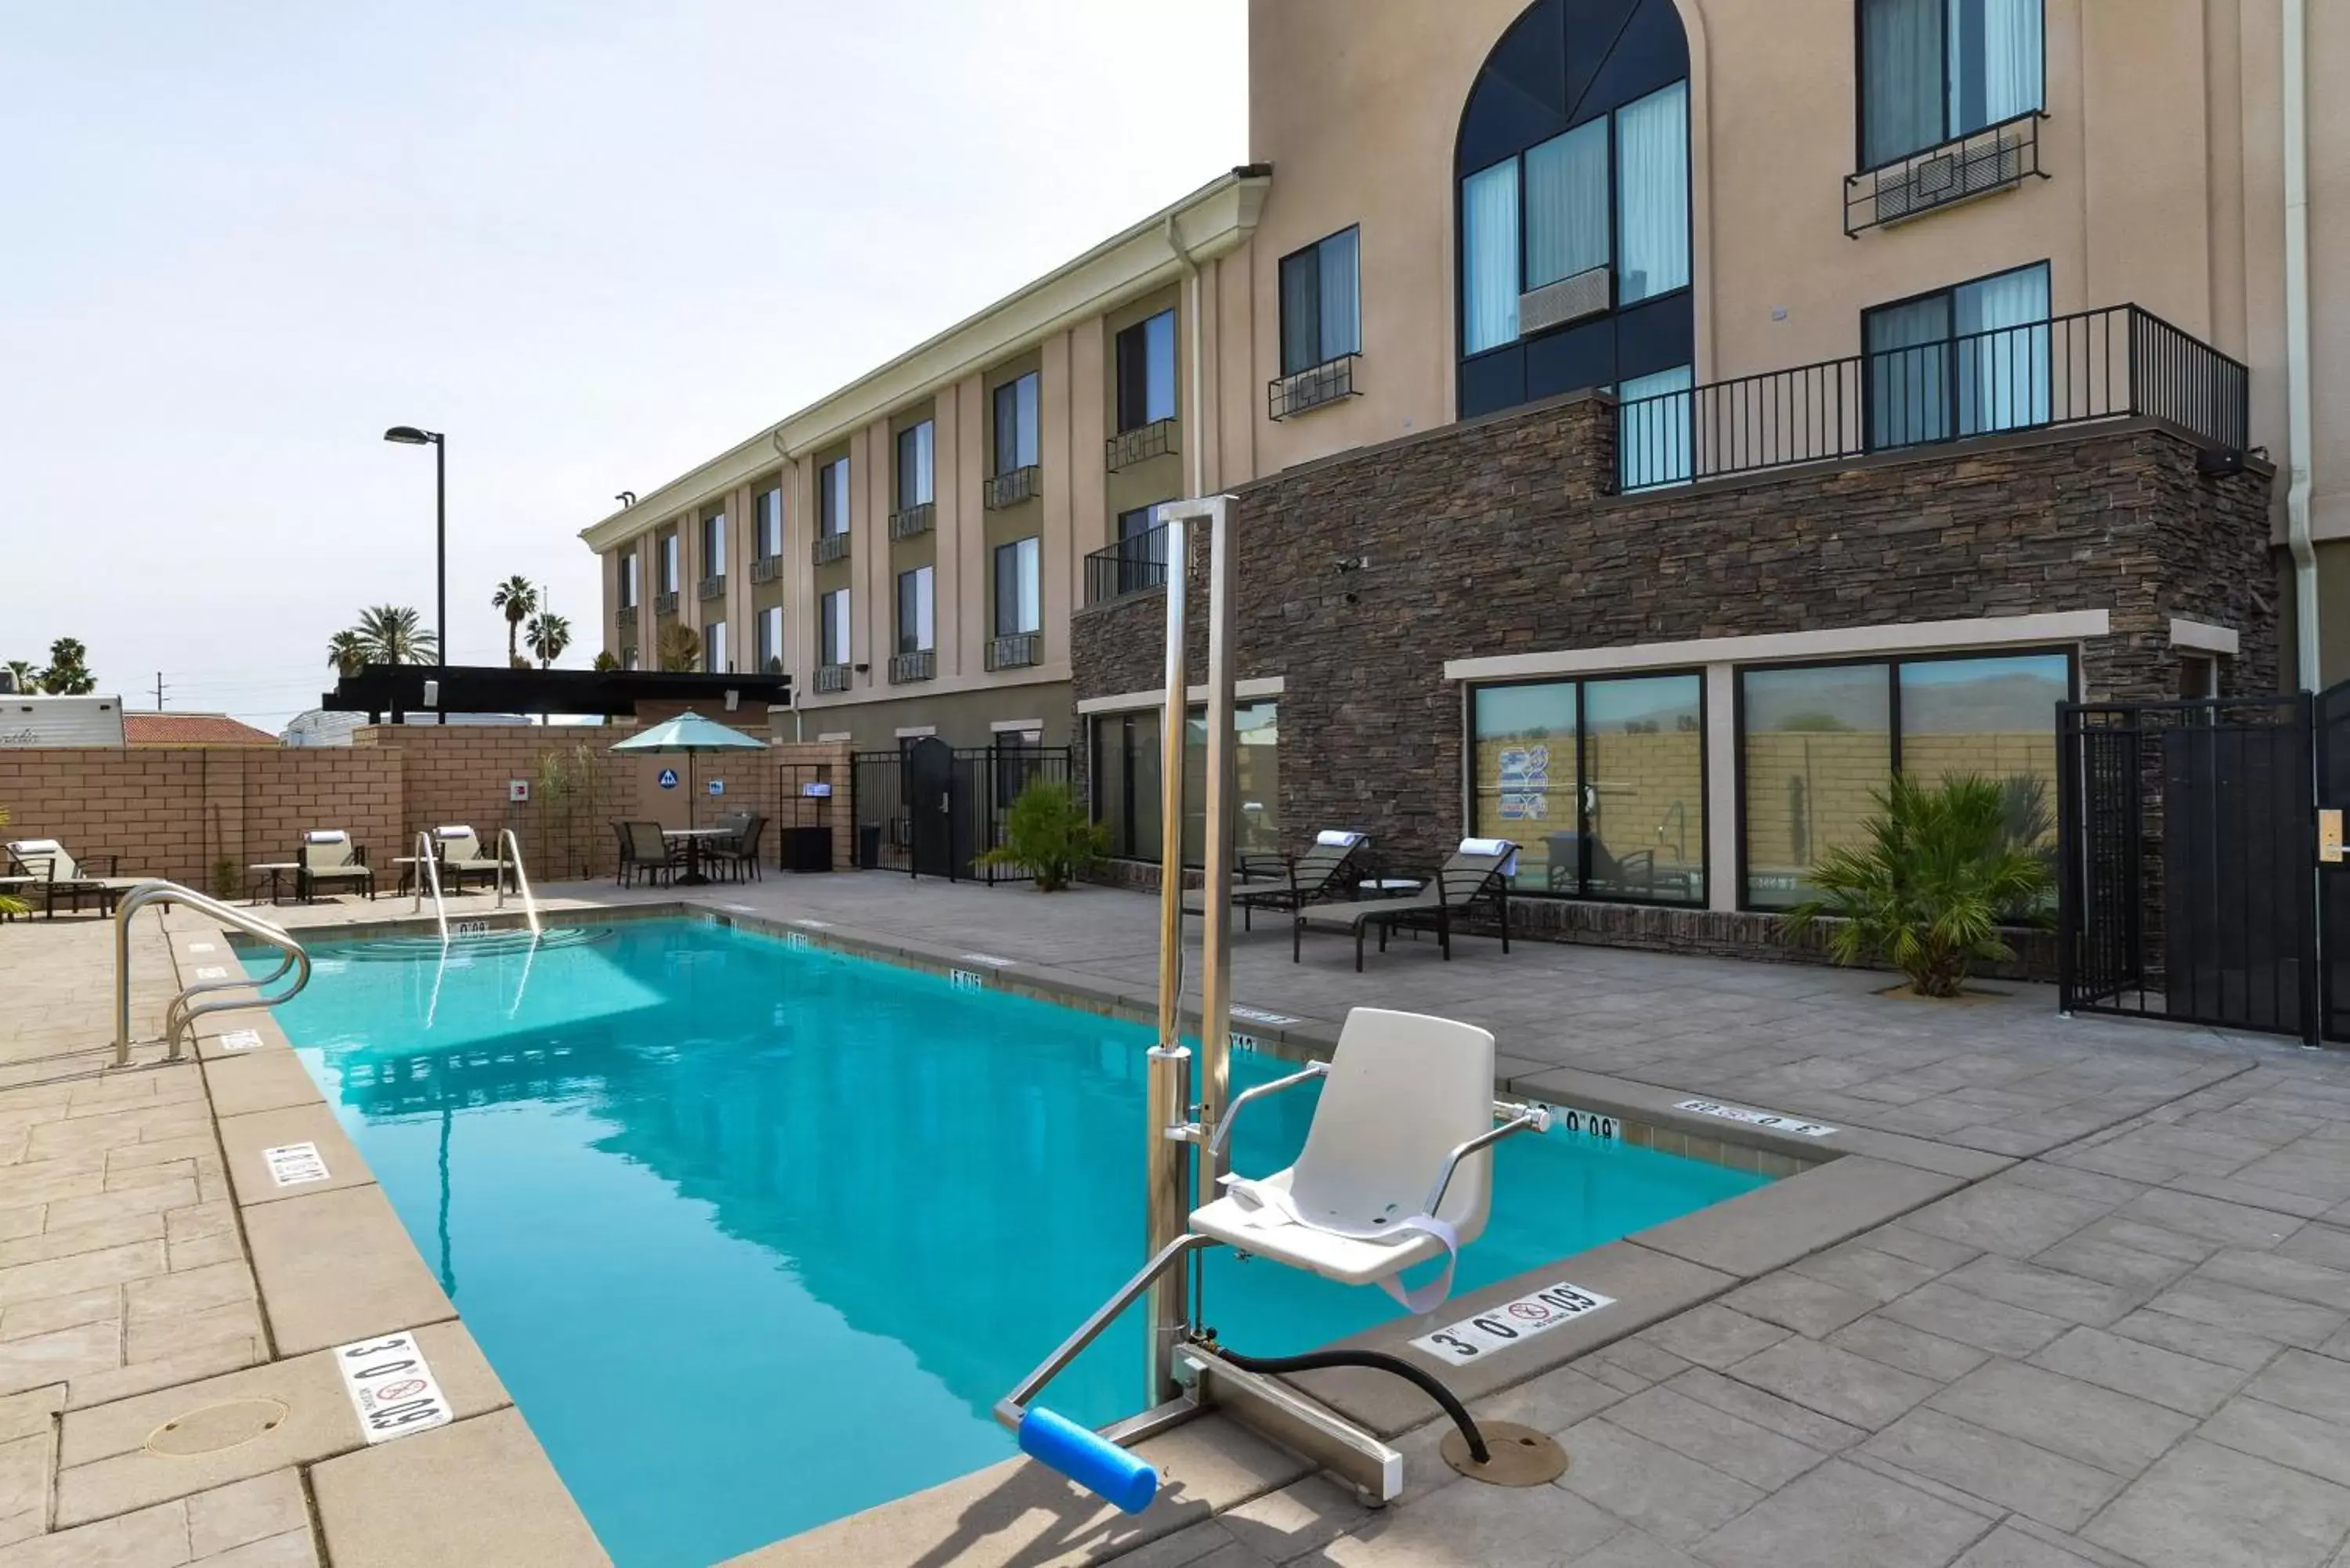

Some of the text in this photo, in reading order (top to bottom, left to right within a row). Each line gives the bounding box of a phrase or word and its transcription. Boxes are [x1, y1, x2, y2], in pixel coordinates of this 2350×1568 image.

[1430, 1333, 1479, 1356] 3
[1472, 1318, 1519, 1339] 0
[1538, 1288, 1596, 1313] 0.9
[345, 1339, 407, 1357] 3
[353, 1359, 416, 1379] 0
[368, 1398, 440, 1429] 0.9
